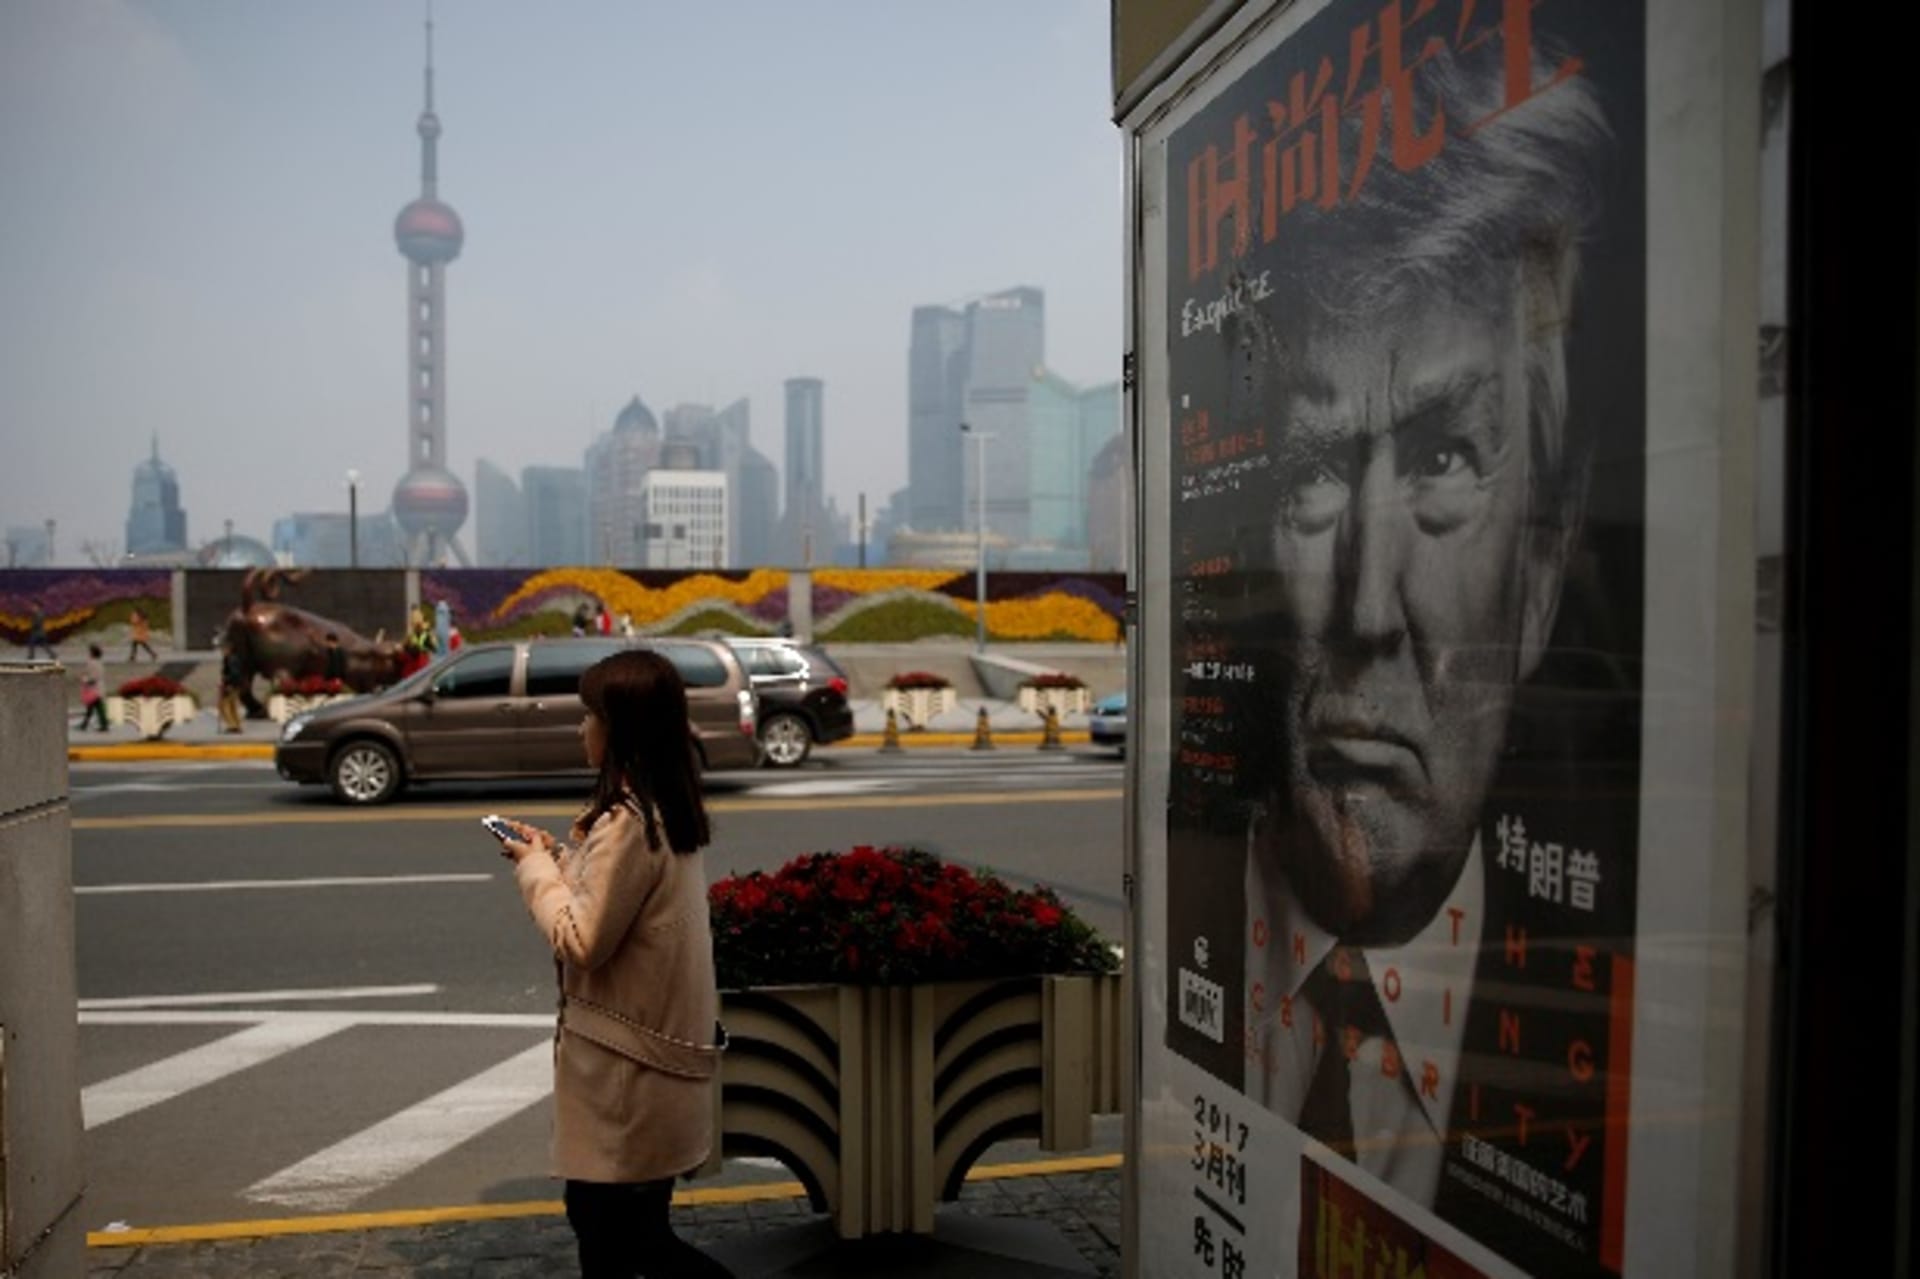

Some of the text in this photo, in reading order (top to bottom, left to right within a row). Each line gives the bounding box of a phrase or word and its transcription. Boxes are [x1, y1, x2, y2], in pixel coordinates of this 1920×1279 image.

[1495, 813, 1600, 912] 特朗普
[1447, 907, 1596, 990] THE
[1194, 1095, 1248, 1152] 2017
[1192, 1130, 1246, 1205] 3月刊
